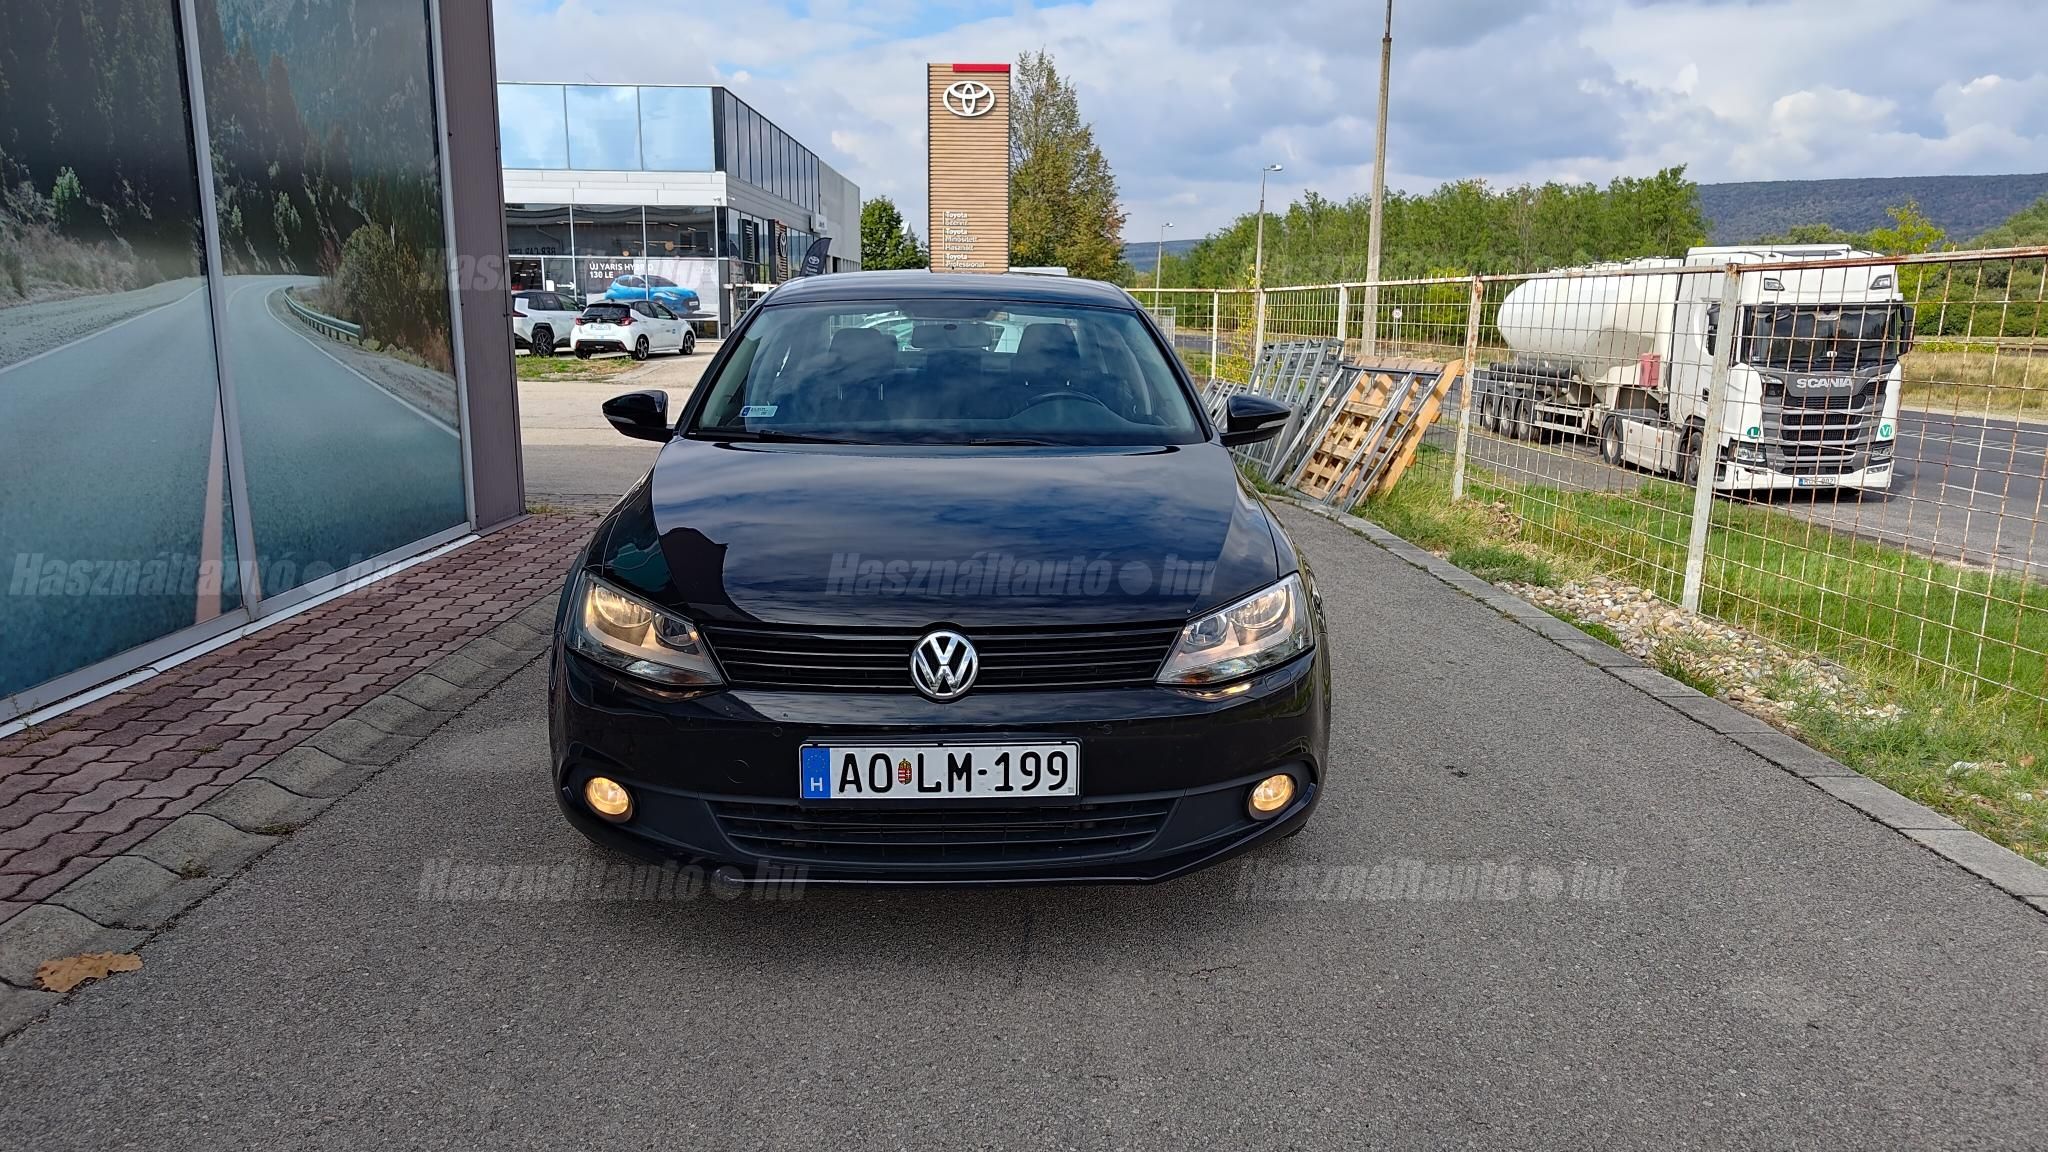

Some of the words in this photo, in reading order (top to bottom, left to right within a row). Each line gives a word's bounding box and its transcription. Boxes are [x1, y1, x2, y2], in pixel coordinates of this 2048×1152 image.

[589, 261, 599, 271] ÚJ
[600, 263, 623, 271] YARIS
[589, 271, 603, 279] 130
[604, 271, 614, 279] LE
[1796, 378, 1853, 389] SCANIA
[810, 777, 823, 792] H
